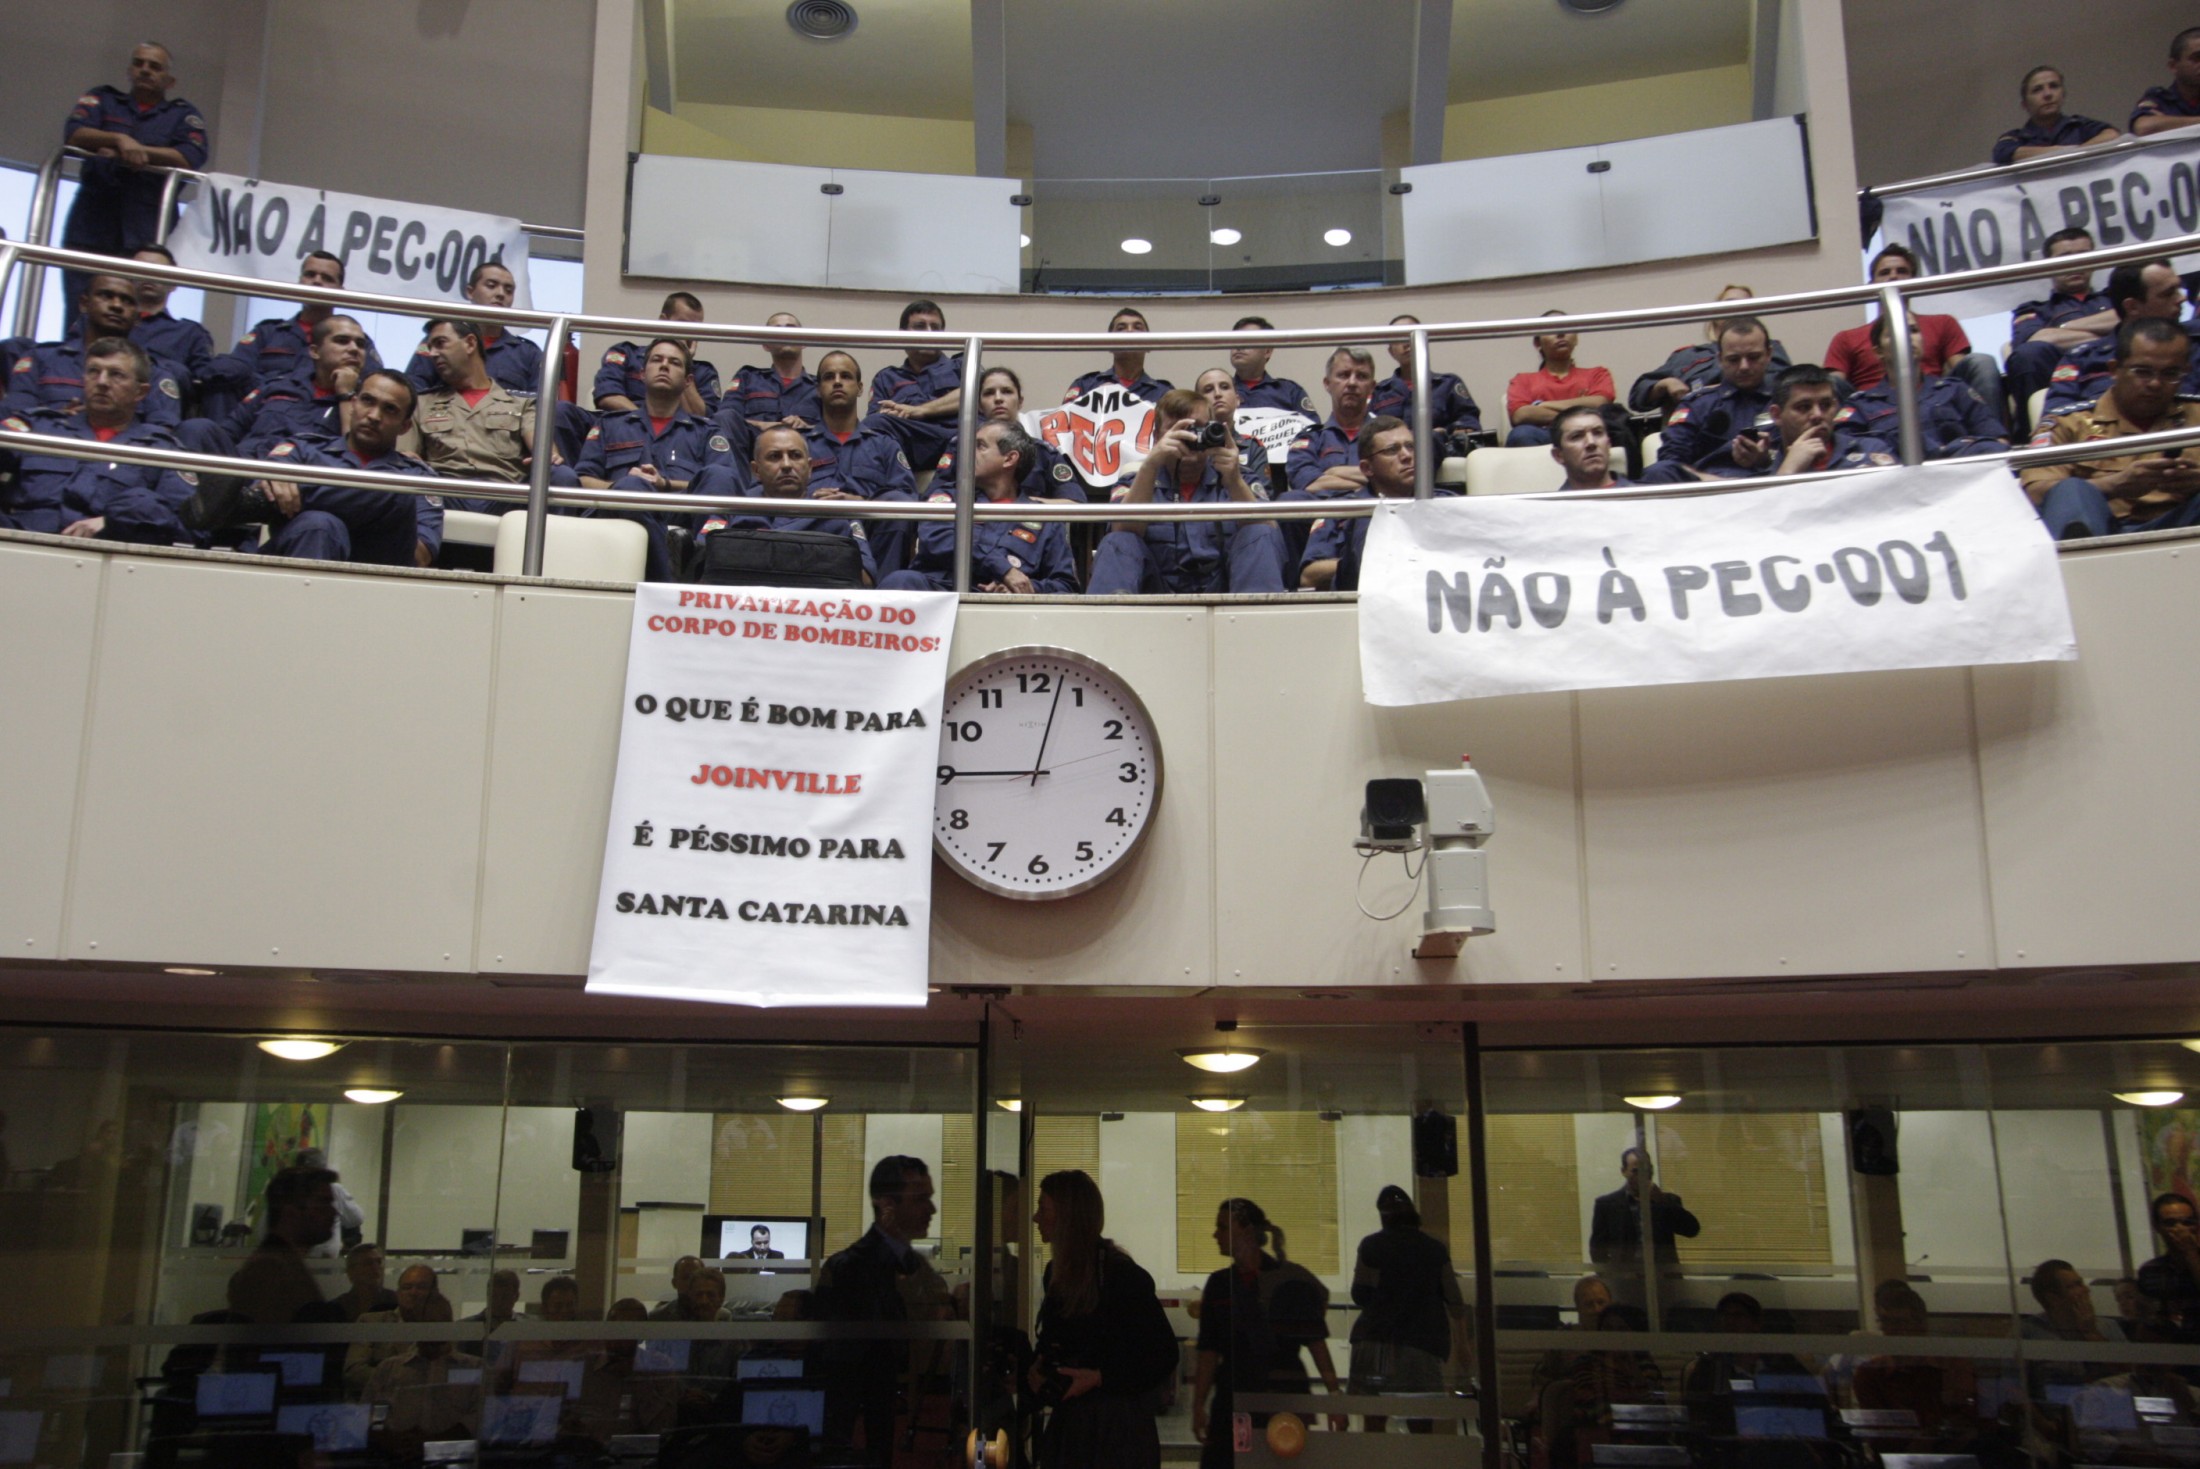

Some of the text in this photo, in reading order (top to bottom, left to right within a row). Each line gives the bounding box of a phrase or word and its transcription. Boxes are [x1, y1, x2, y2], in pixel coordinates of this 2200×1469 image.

[209, 179, 289, 256] NÃO
[1907, 201, 2003, 277] NÃO
[1040, 410, 1125, 476] PEC
[1261, 427, 1296, 443] IGUEL
[1426, 556, 1570, 633] NÃO
[1597, 546, 1646, 624] À
[678, 590, 916, 625] PRIVATIZAÇÃO DO
[647, 615, 941, 652] CORPO DE BOMBEIROS!
[1016, 672, 1051, 693] 12
[977, 689, 1002, 709] 11
[1071, 687, 1084, 707] 1
[635, 694, 927, 732] O QUE É BOM PARA
[946, 720, 983, 742] 10
[1103, 720, 1124, 740] 2
[691, 764, 862, 795] JOINVILLE
[936, 765, 956, 785] 9
[1118, 762, 1139, 783] 3
[949, 809, 969, 830] 8
[1105, 807, 1127, 827] 4
[632, 820, 905, 860] É PÉSSIMO PARA
[986, 842, 1007, 862] 7
[1074, 841, 1095, 862] 5
[1027, 855, 1050, 875] 6
[615, 892, 909, 927] SANTA CATARINA
